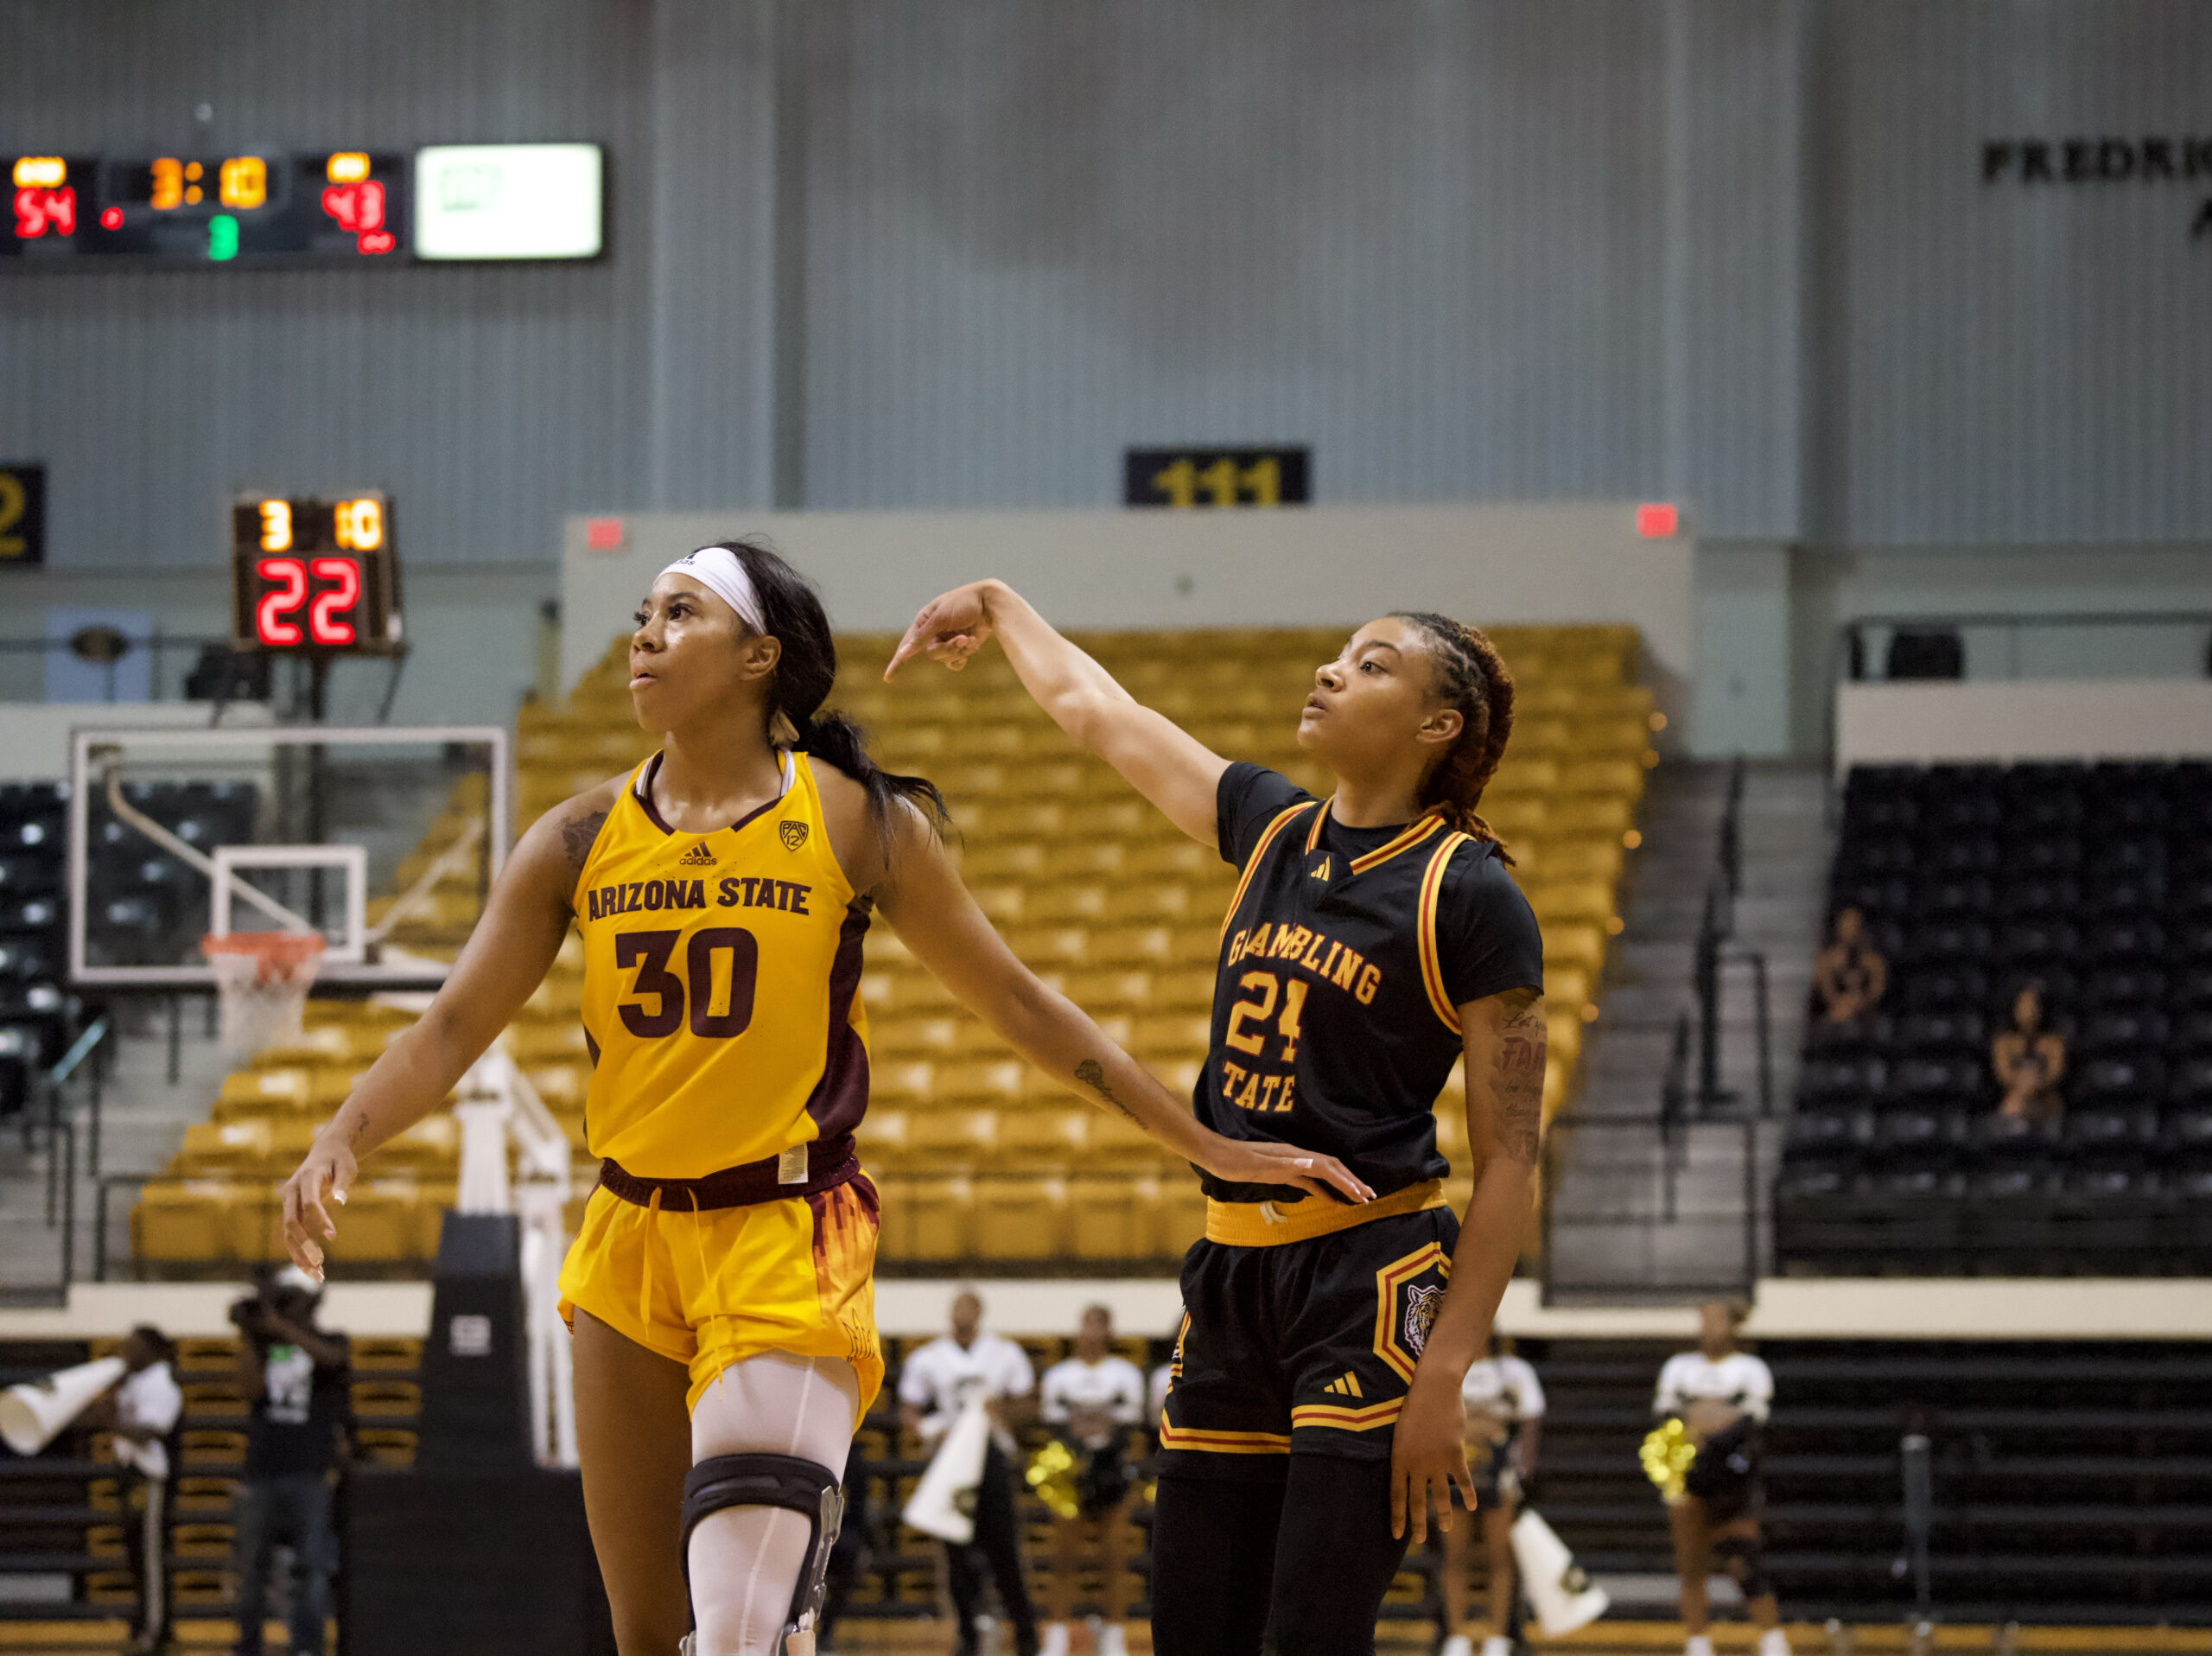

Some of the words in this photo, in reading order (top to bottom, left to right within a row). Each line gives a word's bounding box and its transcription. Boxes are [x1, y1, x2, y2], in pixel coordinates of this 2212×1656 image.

[259, 500, 292, 551] 3
[334, 499, 382, 551] 10
[256, 557, 360, 646] 22
[782, 823, 806, 840] PAC
[787, 835, 799, 846] 12
[679, 856, 717, 866] adidas
[588, 879, 707, 922] ARIZONA
[716, 877, 812, 916] STATE
[615, 927, 758, 1038] 30
[1223, 1060, 1295, 1113] TATE
